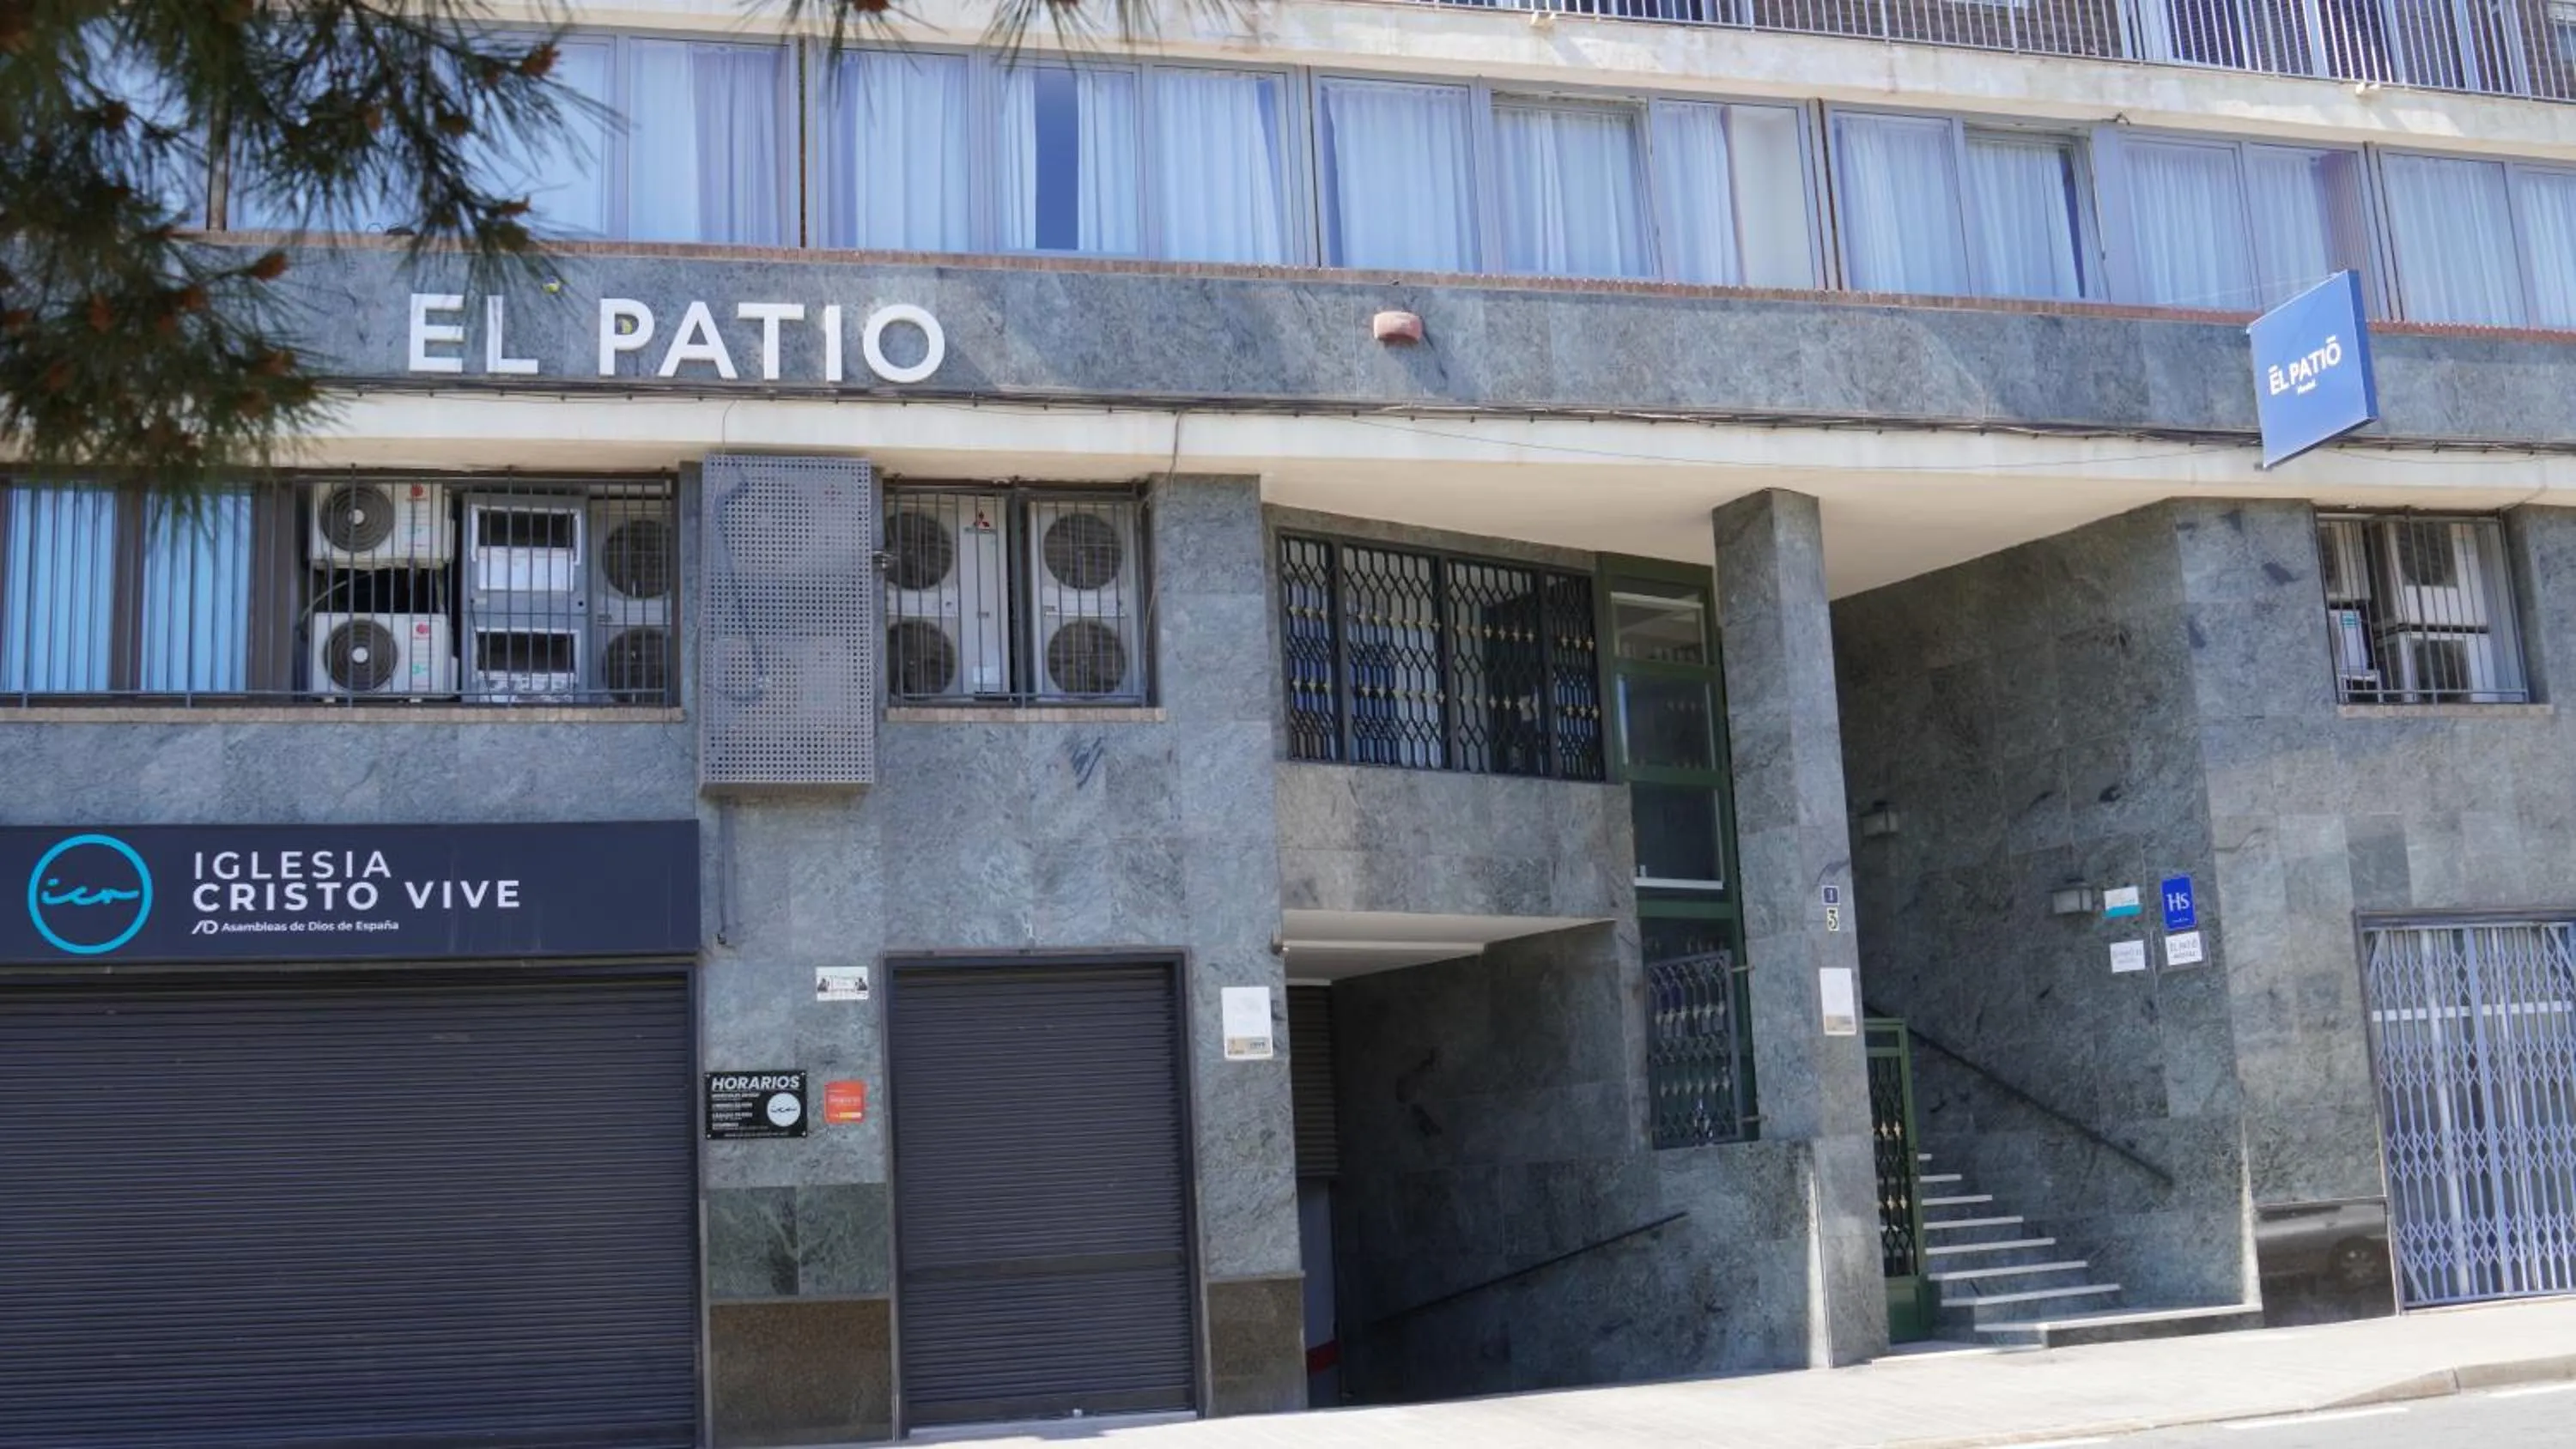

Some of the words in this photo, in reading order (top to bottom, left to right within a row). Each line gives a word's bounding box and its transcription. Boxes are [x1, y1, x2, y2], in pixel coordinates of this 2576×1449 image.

[409, 293, 539, 374] EL
[598, 297, 945, 383] PATIO
[194, 851, 392, 879] IGLESIA
[192, 882, 379, 912] CRISTO
[404, 880, 520, 909] VIVE
[2166, 892, 2190, 912] HS
[222, 921, 288, 932] Asambleas
[290, 920, 306, 931] de
[308, 920, 336, 931] Dios
[337, 920, 353, 931] de
[355, 919, 399, 932] España
[712, 1076, 800, 1092] HORARIOS
